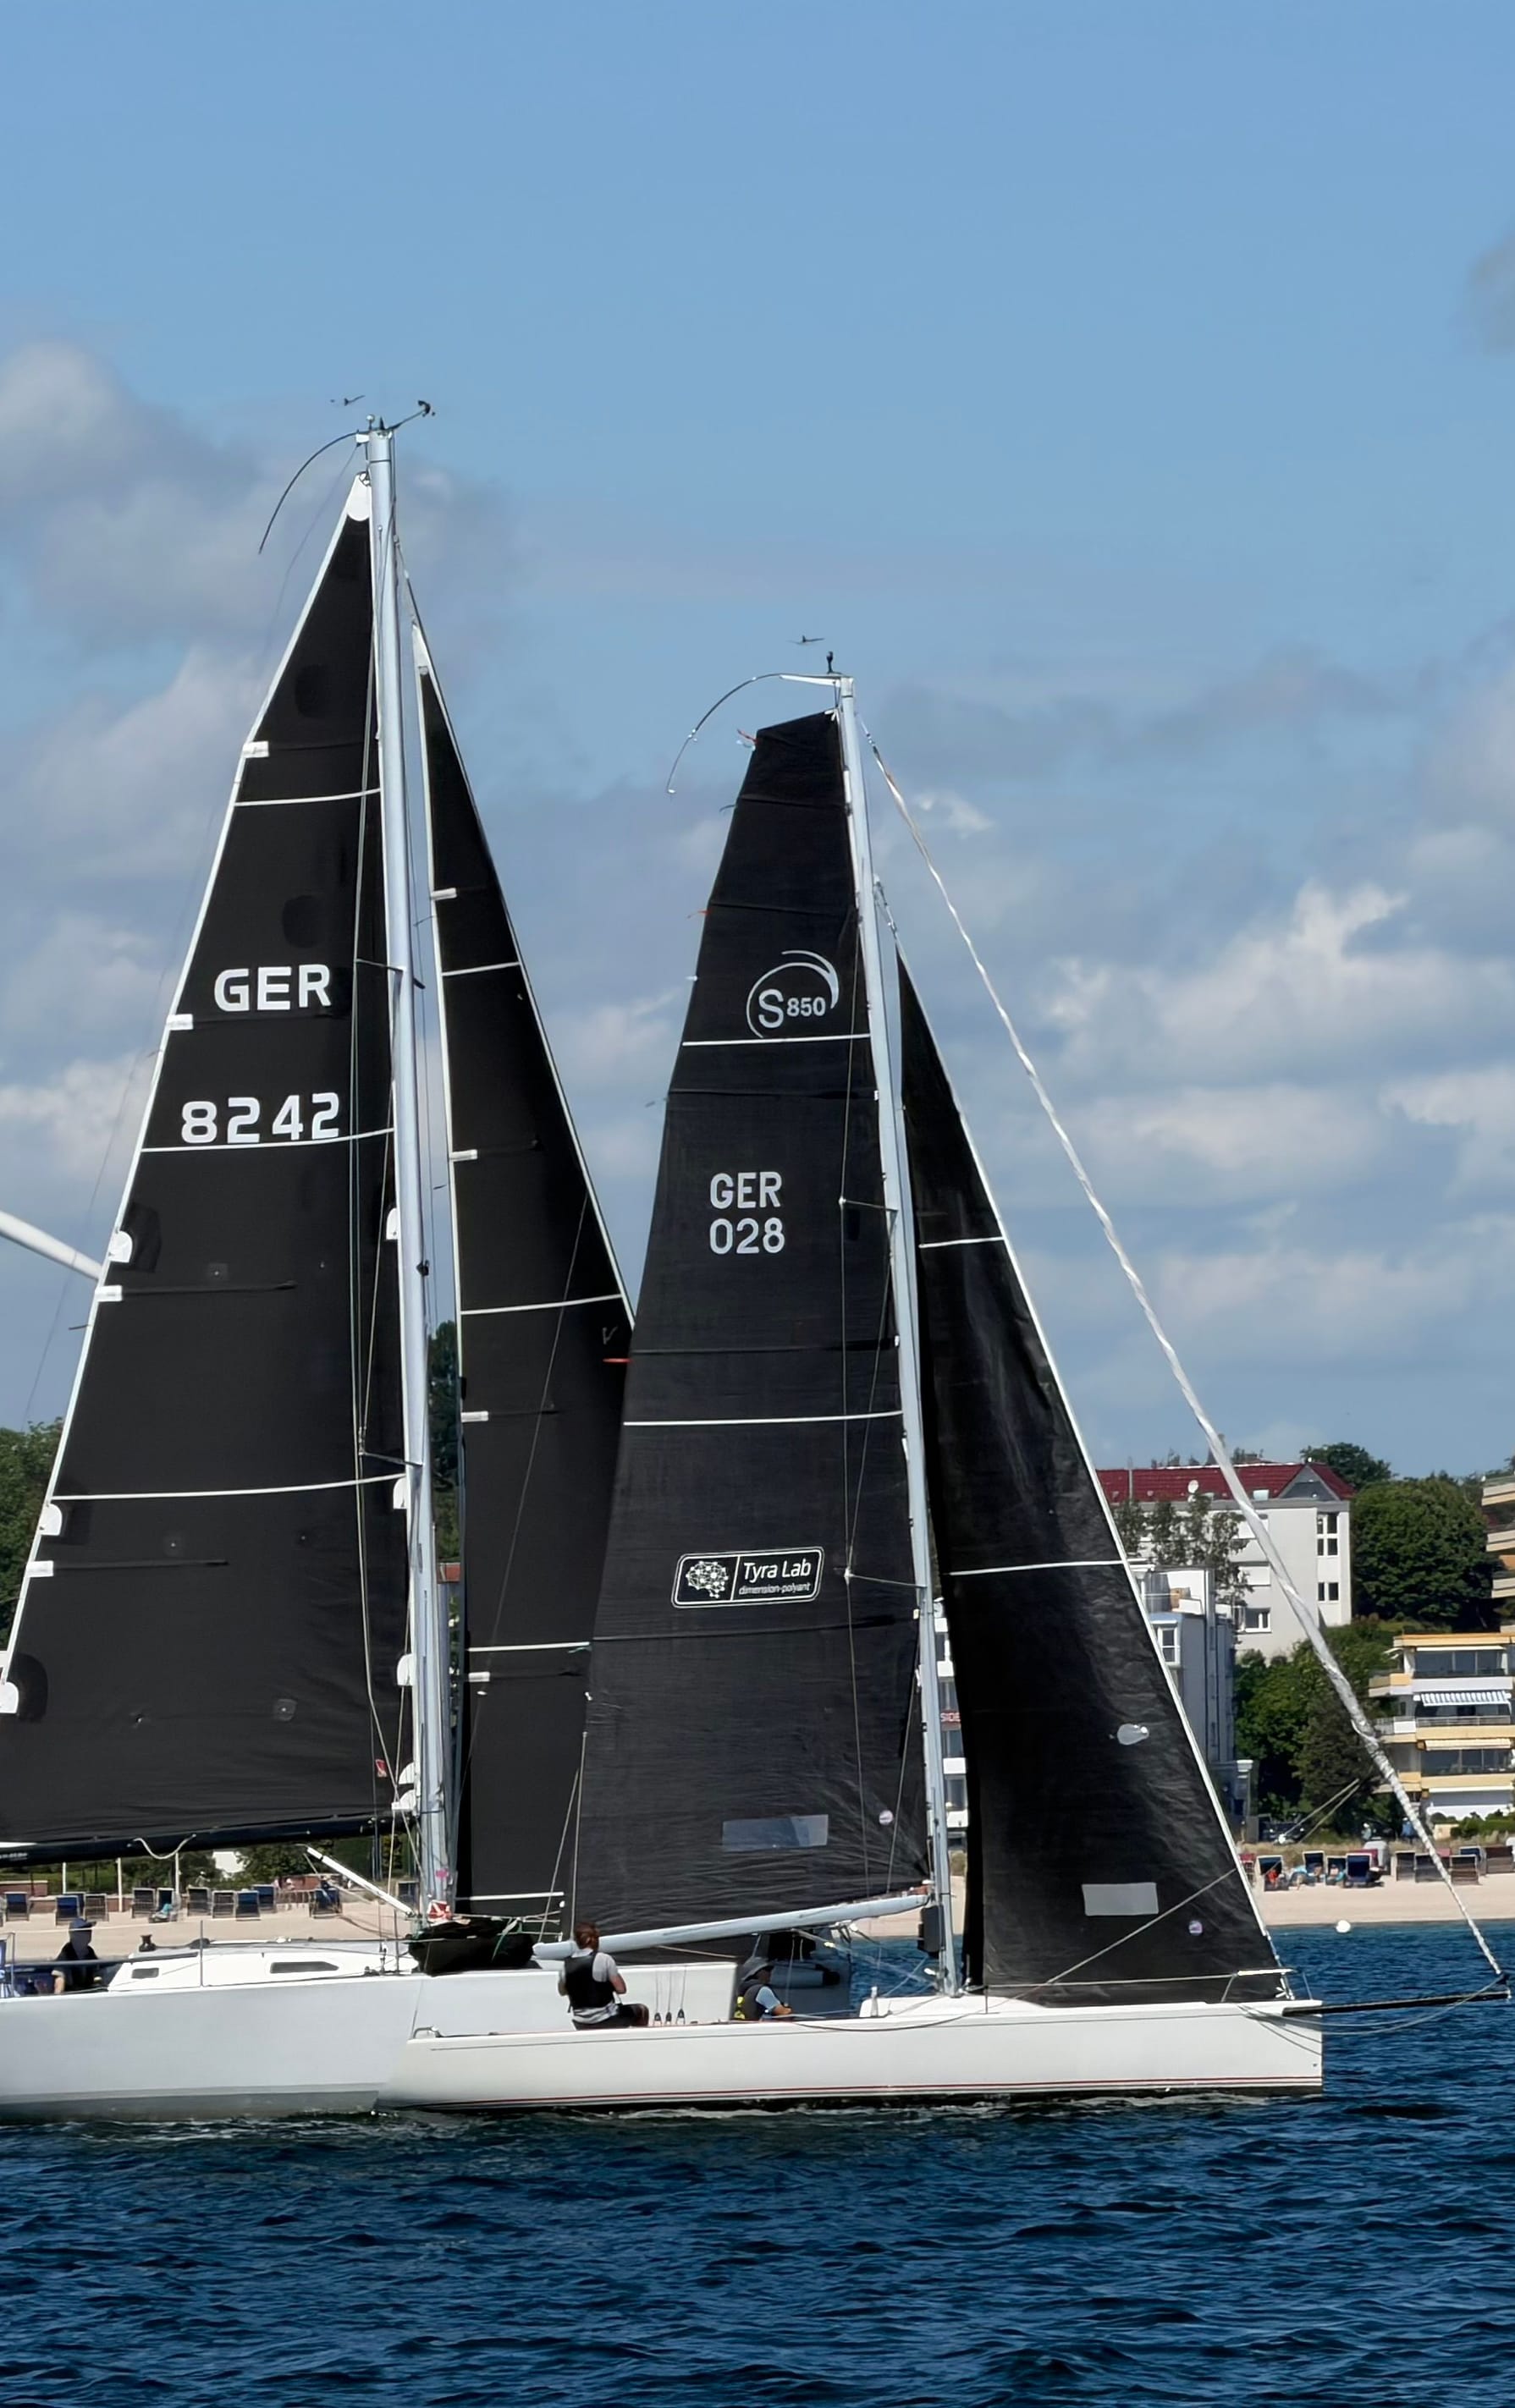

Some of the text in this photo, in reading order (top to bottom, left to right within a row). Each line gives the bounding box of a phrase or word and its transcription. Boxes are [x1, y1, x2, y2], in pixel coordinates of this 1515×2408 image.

[214, 964, 332, 1012] GER
[181, 1091, 339, 1144] 8242
[709, 1171, 782, 1210] GER
[709, 1217, 785, 1255] 028
[743, 1558, 812, 1583] Tyra Lab
